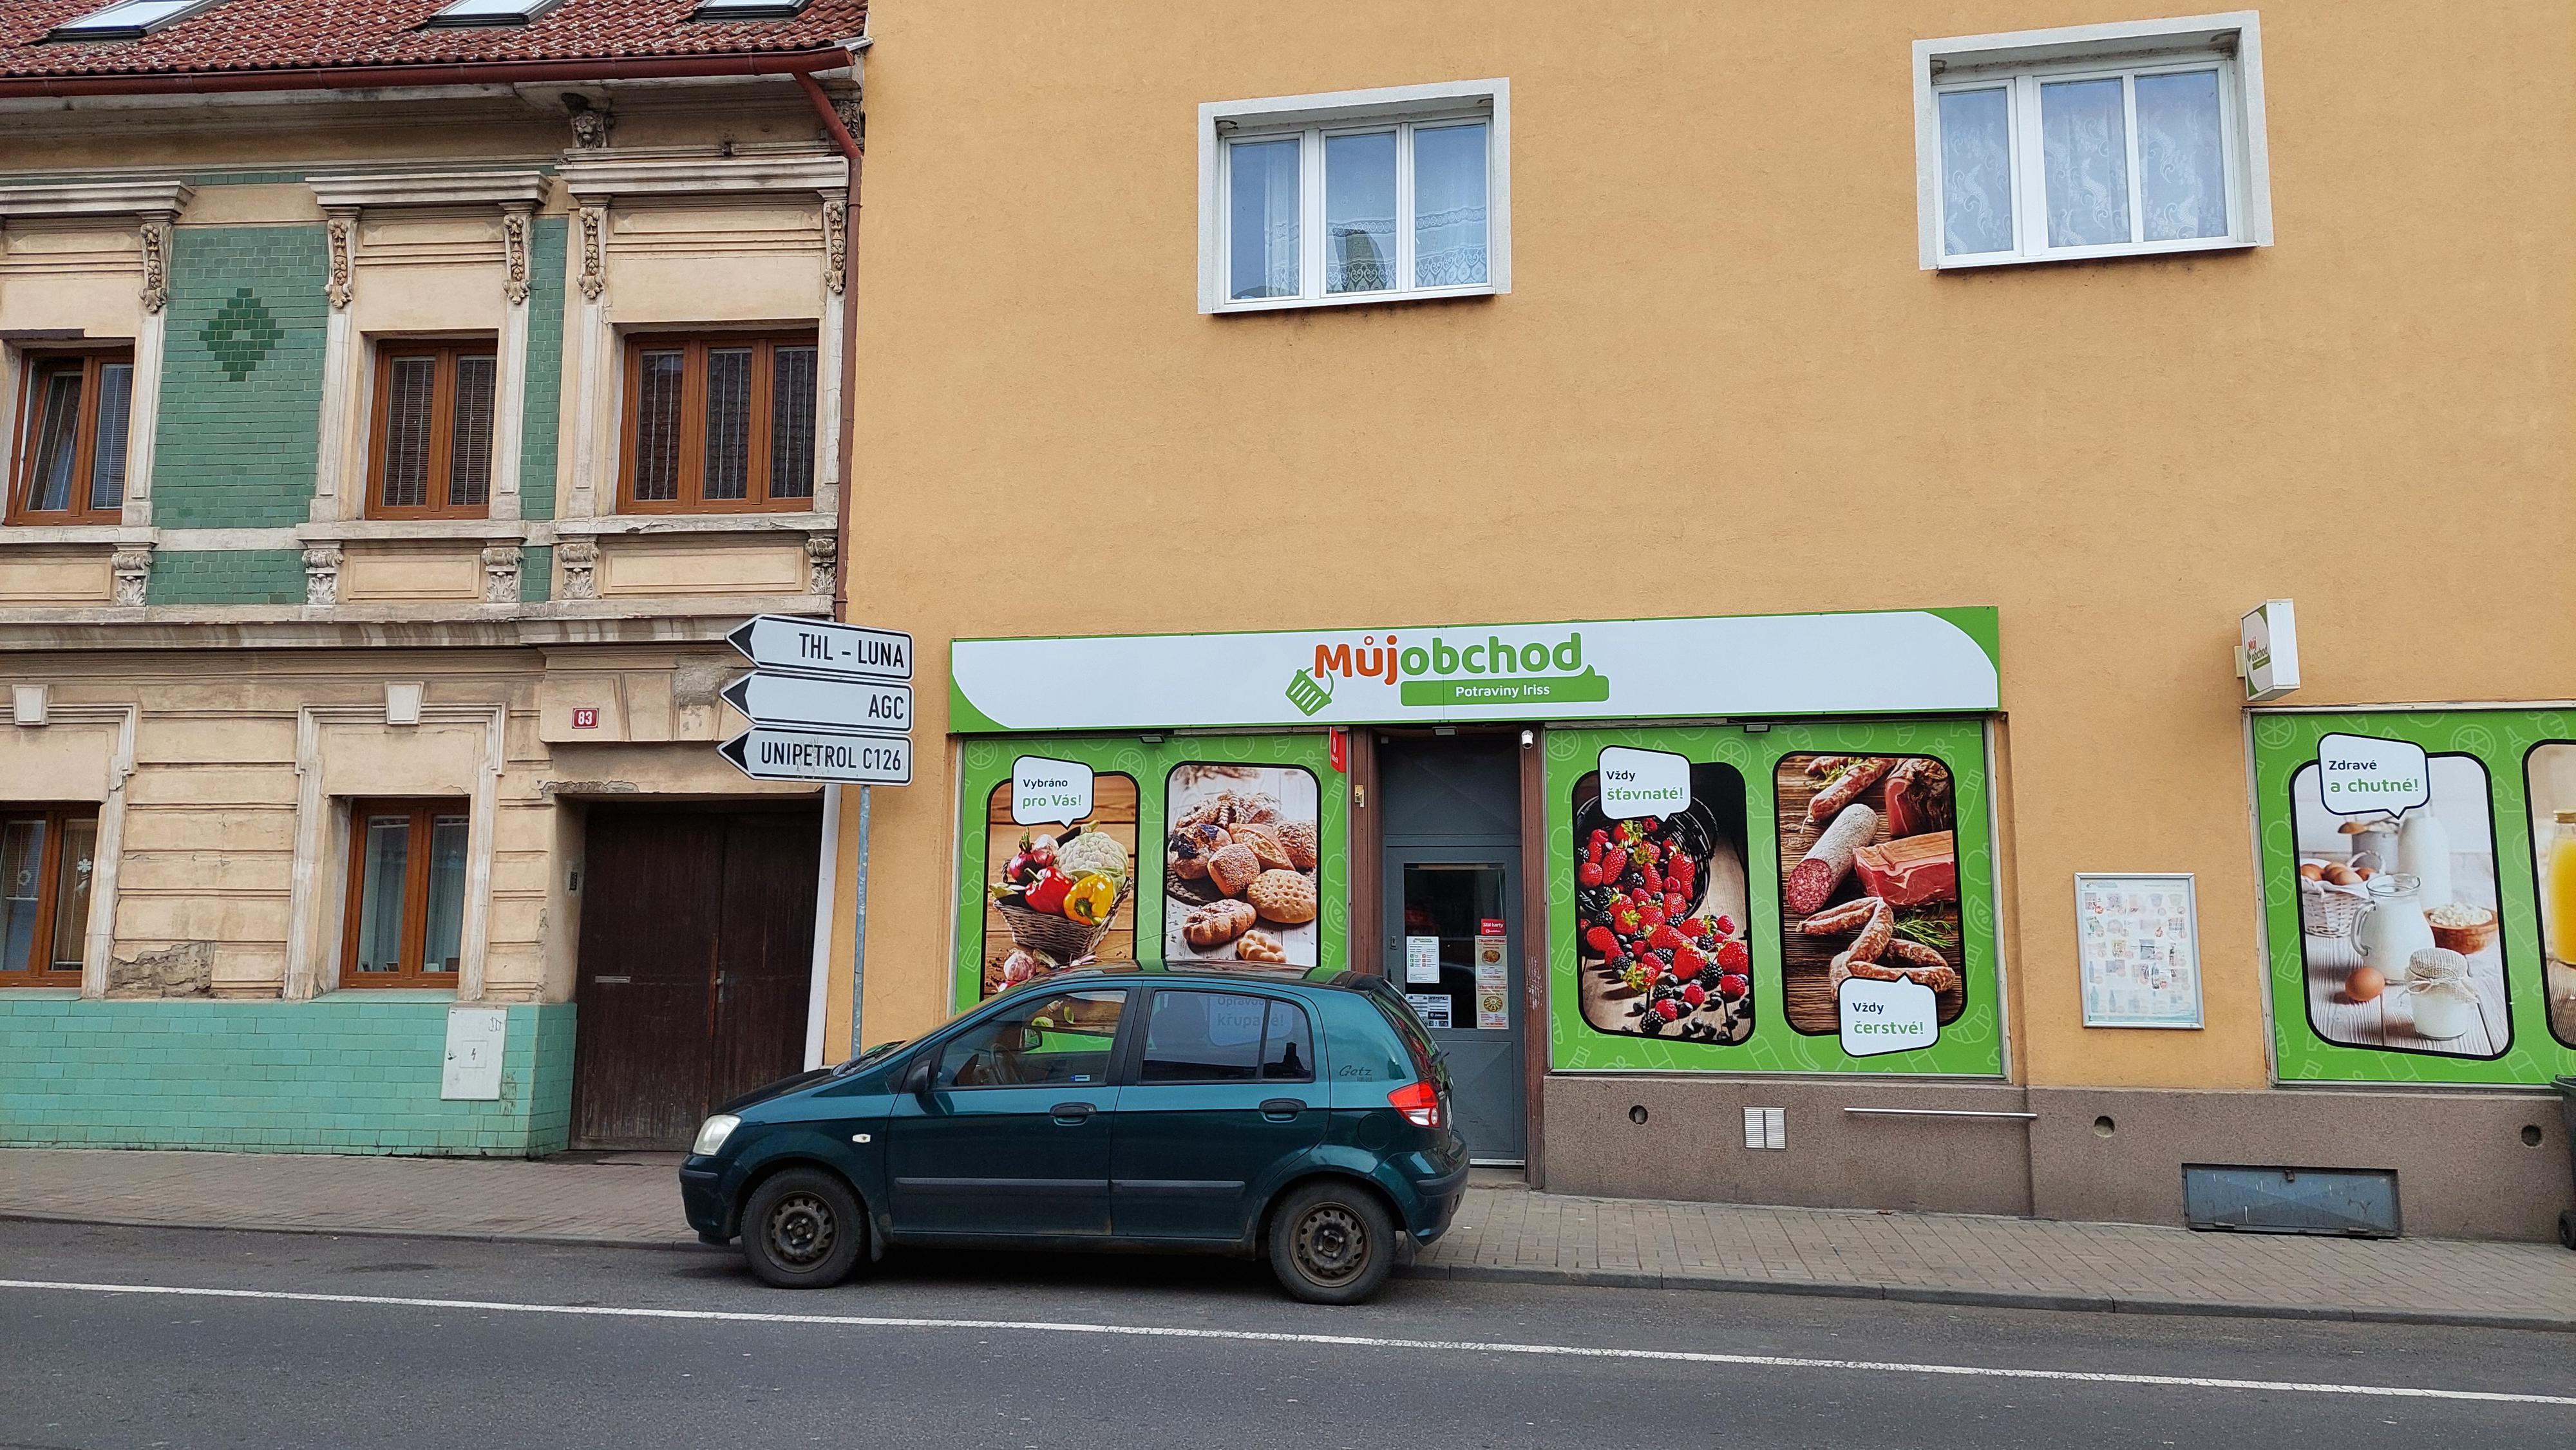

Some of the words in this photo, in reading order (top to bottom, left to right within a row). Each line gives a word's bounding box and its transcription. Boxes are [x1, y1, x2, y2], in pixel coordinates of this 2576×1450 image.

[799, 633, 834, 661] THL
[858, 639, 905, 668] LUNA
[1455, 685, 1519, 698] Potraviny
[1523, 684, 1550, 696] Iriss
[867, 693, 904, 720] AGC
[578, 711, 592, 725] 83
[761, 741, 857, 769] UNIPETROL
[863, 748, 901, 771] C126
[2328, 760, 2377, 771] Zdravé
[1606, 770, 1636, 782] Vždy
[1023, 778, 1068, 790] Vybráno
[2330, 781, 2341, 793] a
[2347, 778, 2419, 793] chutné!
[1607, 787, 1683, 800] šťavnaté!
[1023, 797, 1046, 810] pro
[1051, 794, 1082, 806] Vás!
[1852, 1002, 1884, 1015] Vždy
[1217, 1013, 1283, 1029] křupaé!
[1853, 1021, 1924, 1035] čerstvé!
[1340, 1065, 1372, 1077] Getz
